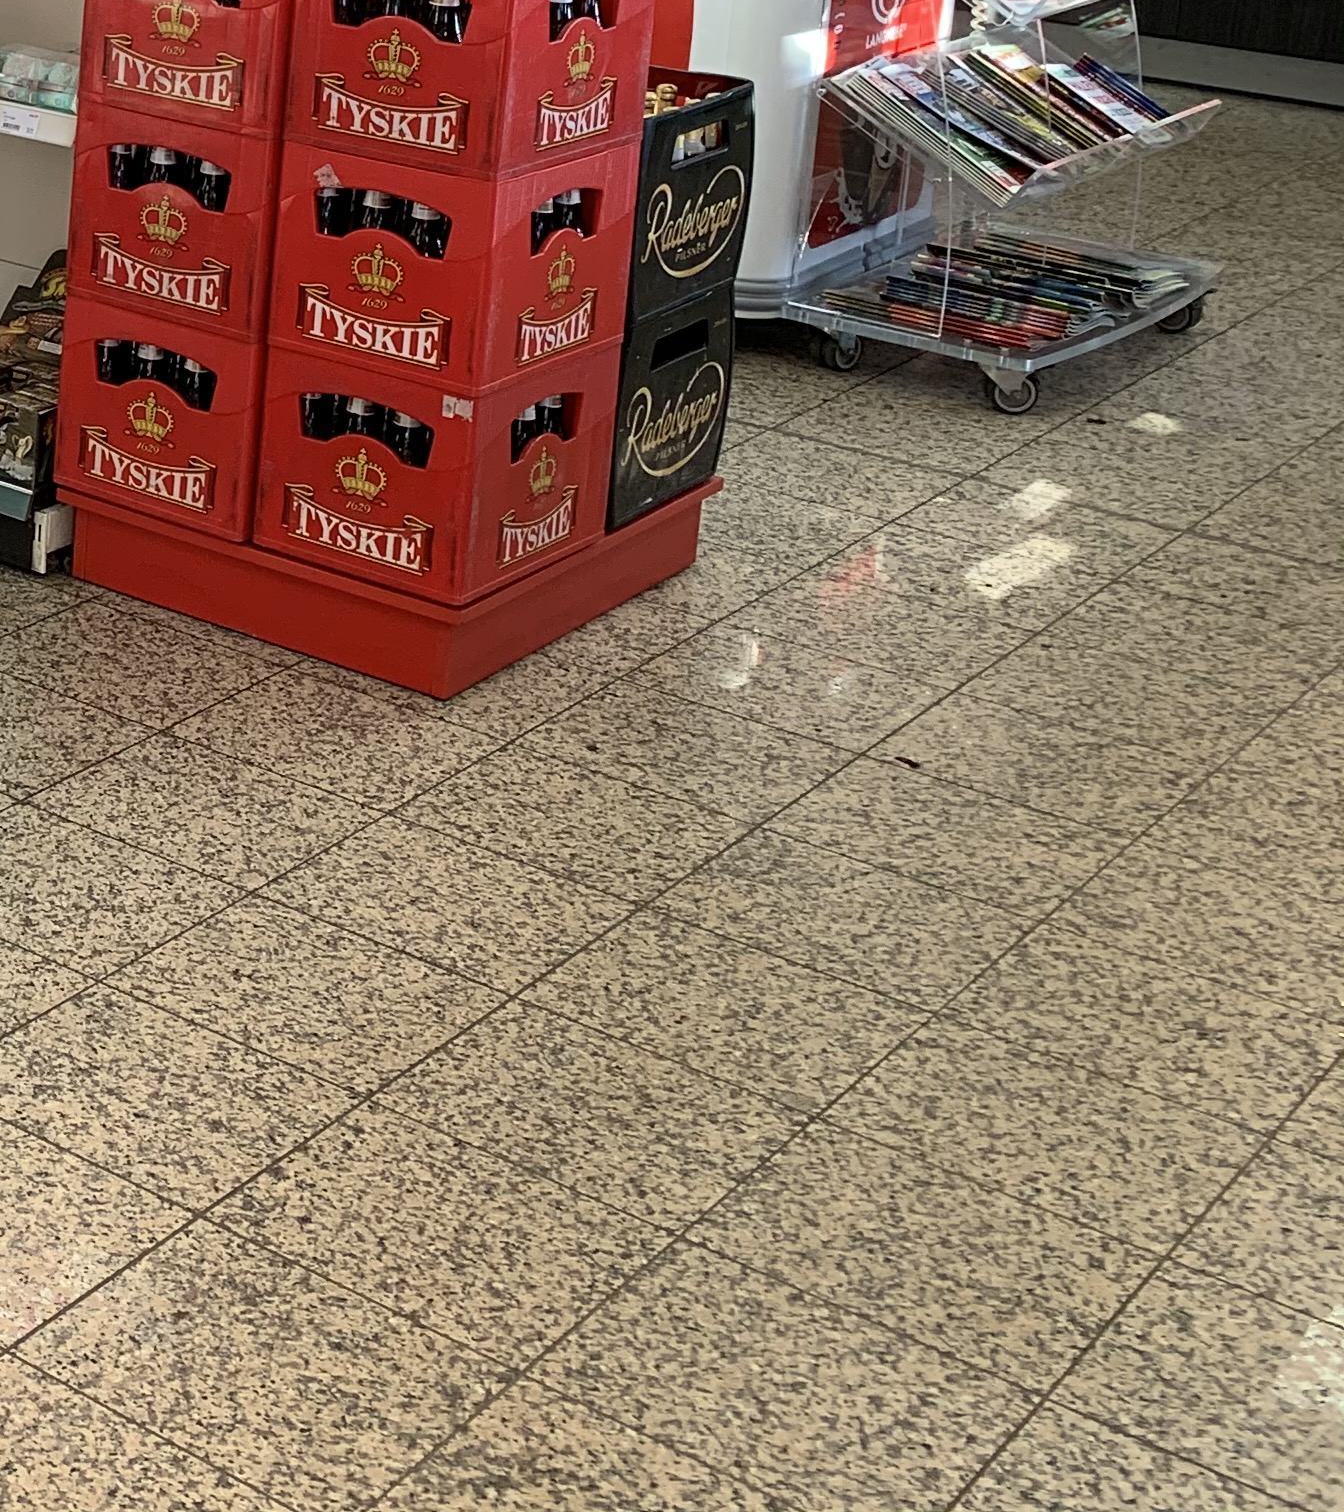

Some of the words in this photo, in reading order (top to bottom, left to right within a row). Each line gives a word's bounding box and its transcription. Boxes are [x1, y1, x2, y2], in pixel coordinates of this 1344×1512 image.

[110, 52, 235, 110] TYSKIE
[377, 83, 405, 98] 1629
[320, 91, 460, 152] TYSKIE
[539, 89, 611, 148] TYSKIE
[641, 183, 740, 263] Radeberger
[674, 242, 706, 262] PILSNER
[100, 250, 222, 313] TYSKIE
[360, 297, 389, 310] 1629
[306, 302, 444, 368] TYSKIE
[519, 300, 591, 360] TYSKIE
[621, 386, 718, 466] Radeberger
[86, 442, 208, 511] TYSKIE
[344, 499, 372, 513] 1629
[292, 500, 425, 571] TYSKIE
[501, 506, 571, 565] TYSKIE
